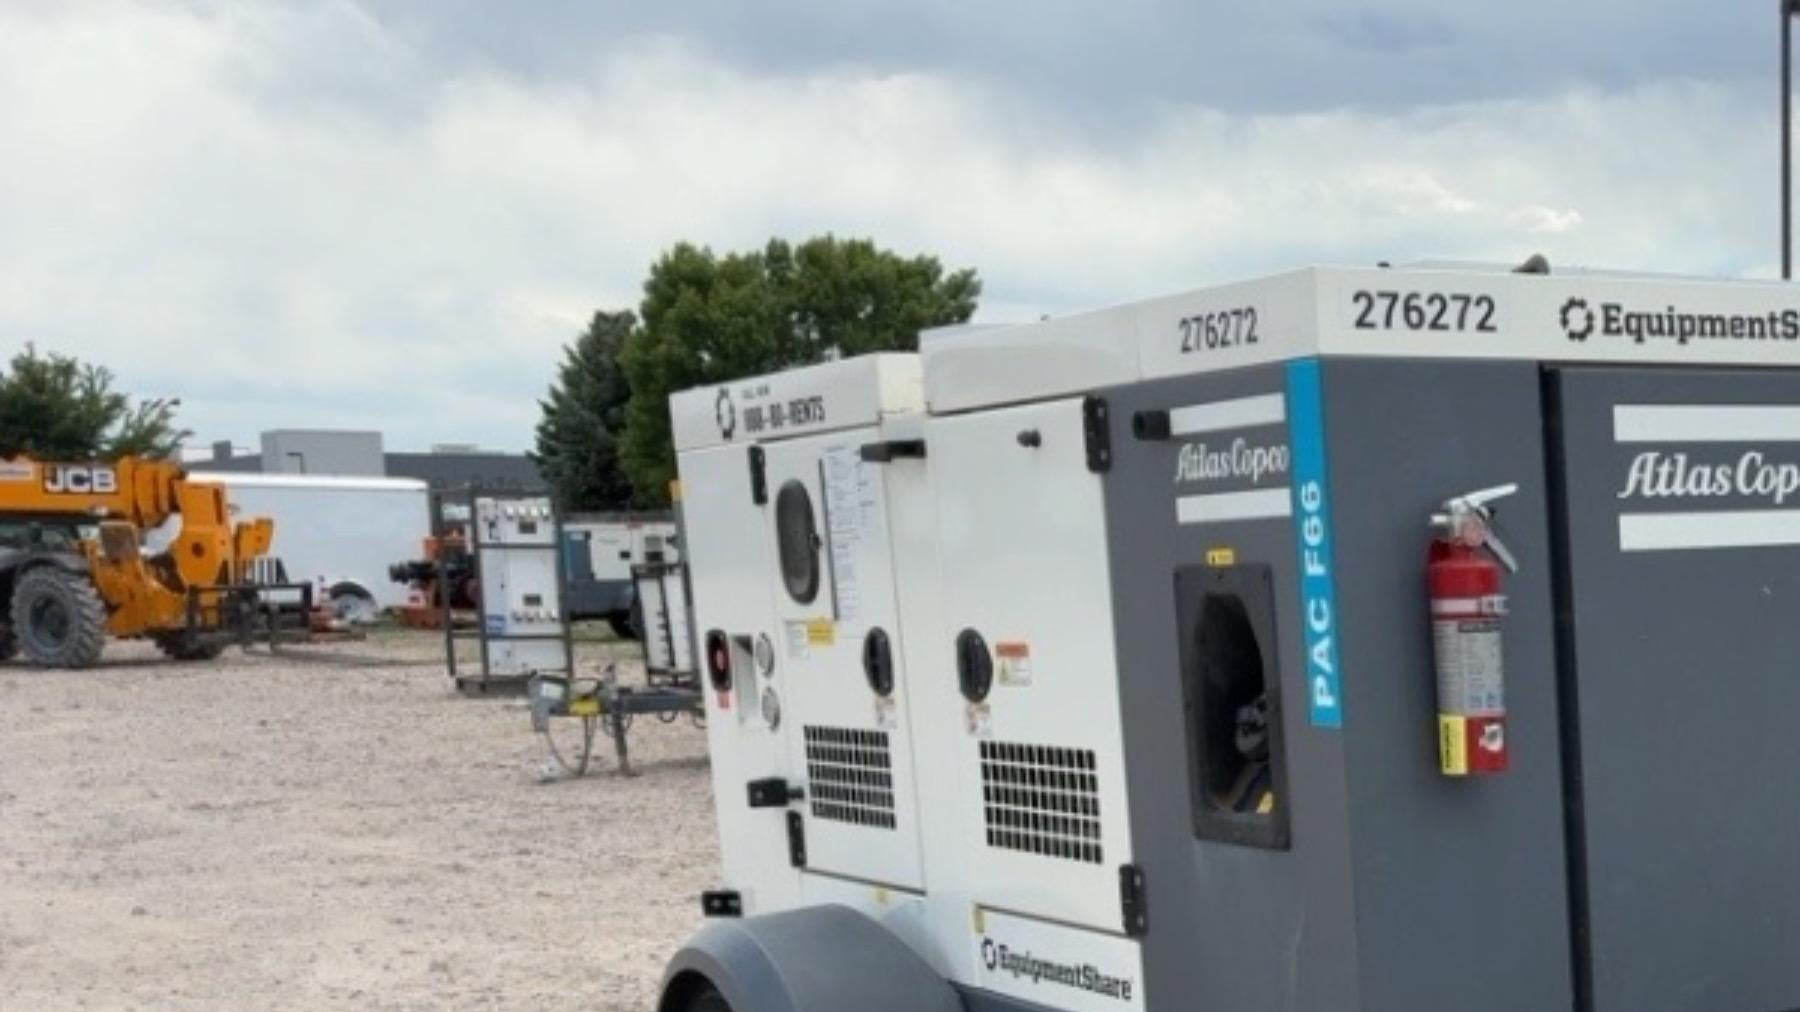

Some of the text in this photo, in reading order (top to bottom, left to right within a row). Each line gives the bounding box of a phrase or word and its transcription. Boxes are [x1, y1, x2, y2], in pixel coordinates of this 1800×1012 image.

[1178, 307, 1258, 353] 276272
[1352, 291, 1497, 333] 276272
[44, 465, 118, 493] JCB
[1174, 437, 1290, 484] Atlas Copco
[1616, 450, 1733, 498] Atlas
[1301, 479, 1336, 708] PAC F66
[998, 943, 1132, 1001] EquipmentShare
